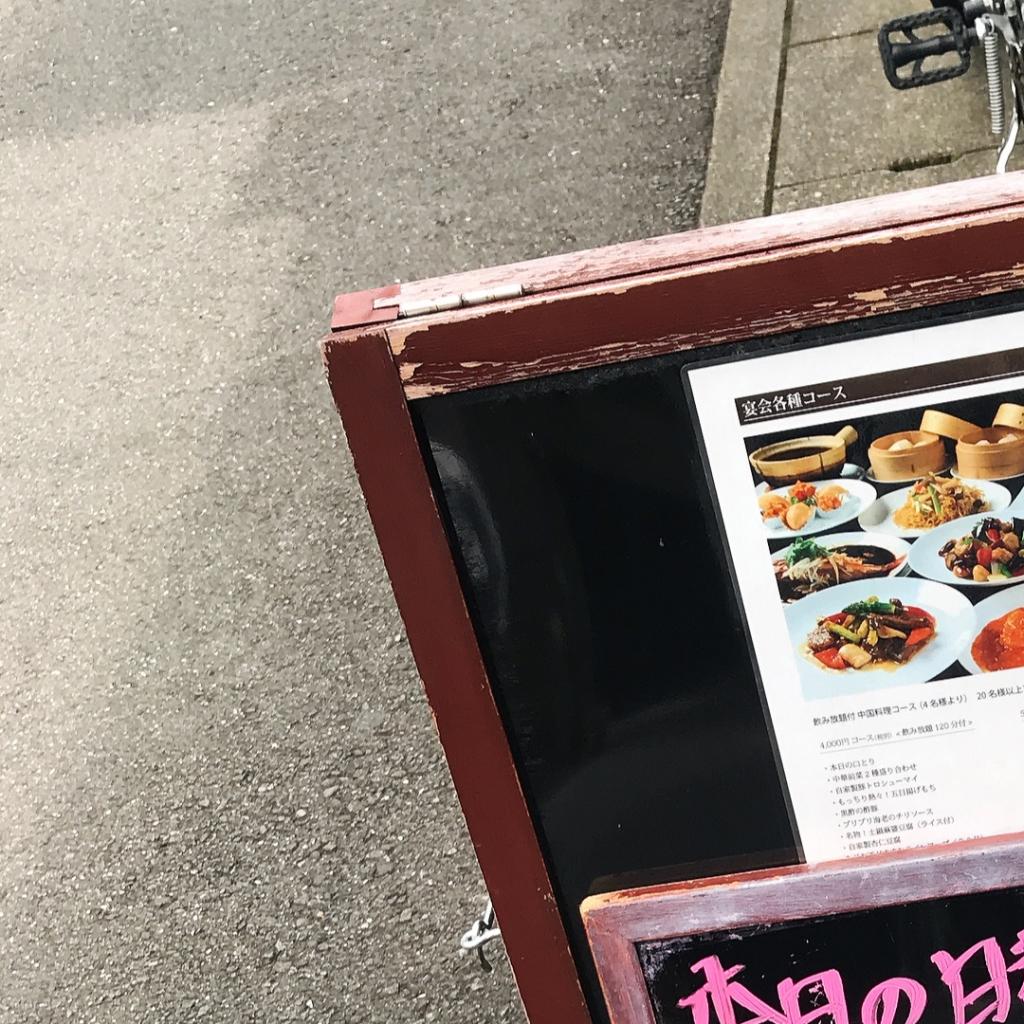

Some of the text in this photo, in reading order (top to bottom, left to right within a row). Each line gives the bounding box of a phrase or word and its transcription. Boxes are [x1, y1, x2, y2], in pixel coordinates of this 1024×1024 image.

[741, 385, 847, 418] 宴会各種コース
